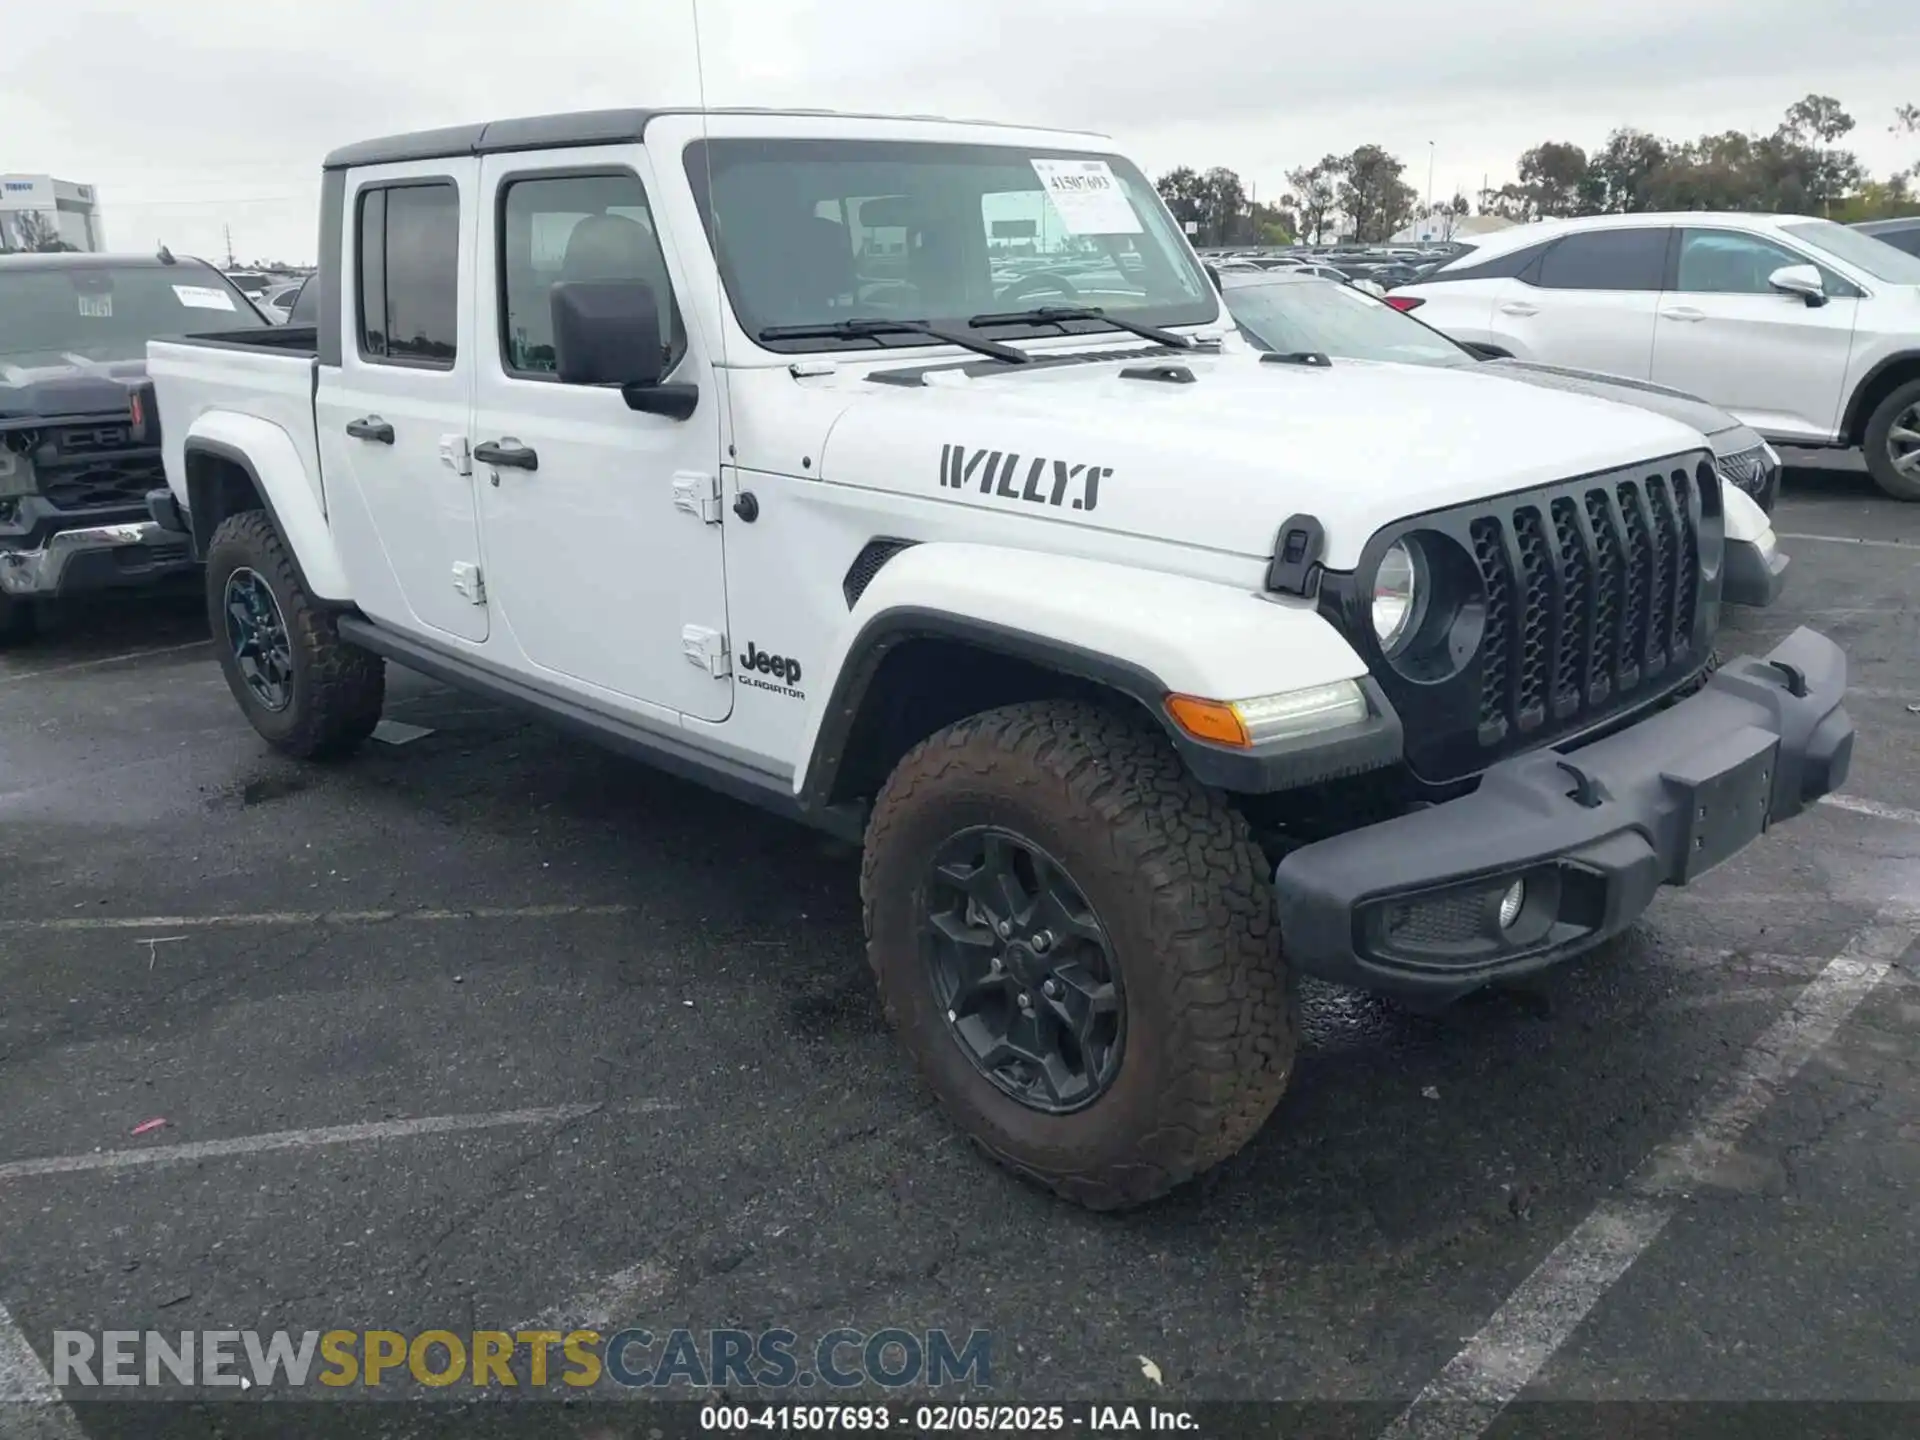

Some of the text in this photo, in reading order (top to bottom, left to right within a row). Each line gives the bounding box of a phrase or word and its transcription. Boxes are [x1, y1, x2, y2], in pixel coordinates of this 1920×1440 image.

[1050, 175, 1110, 190] 41507693
[940, 443, 1114, 511] WILLYS
[739, 641, 802, 686] Jeep
[738, 675, 806, 701] GLADIATOR
